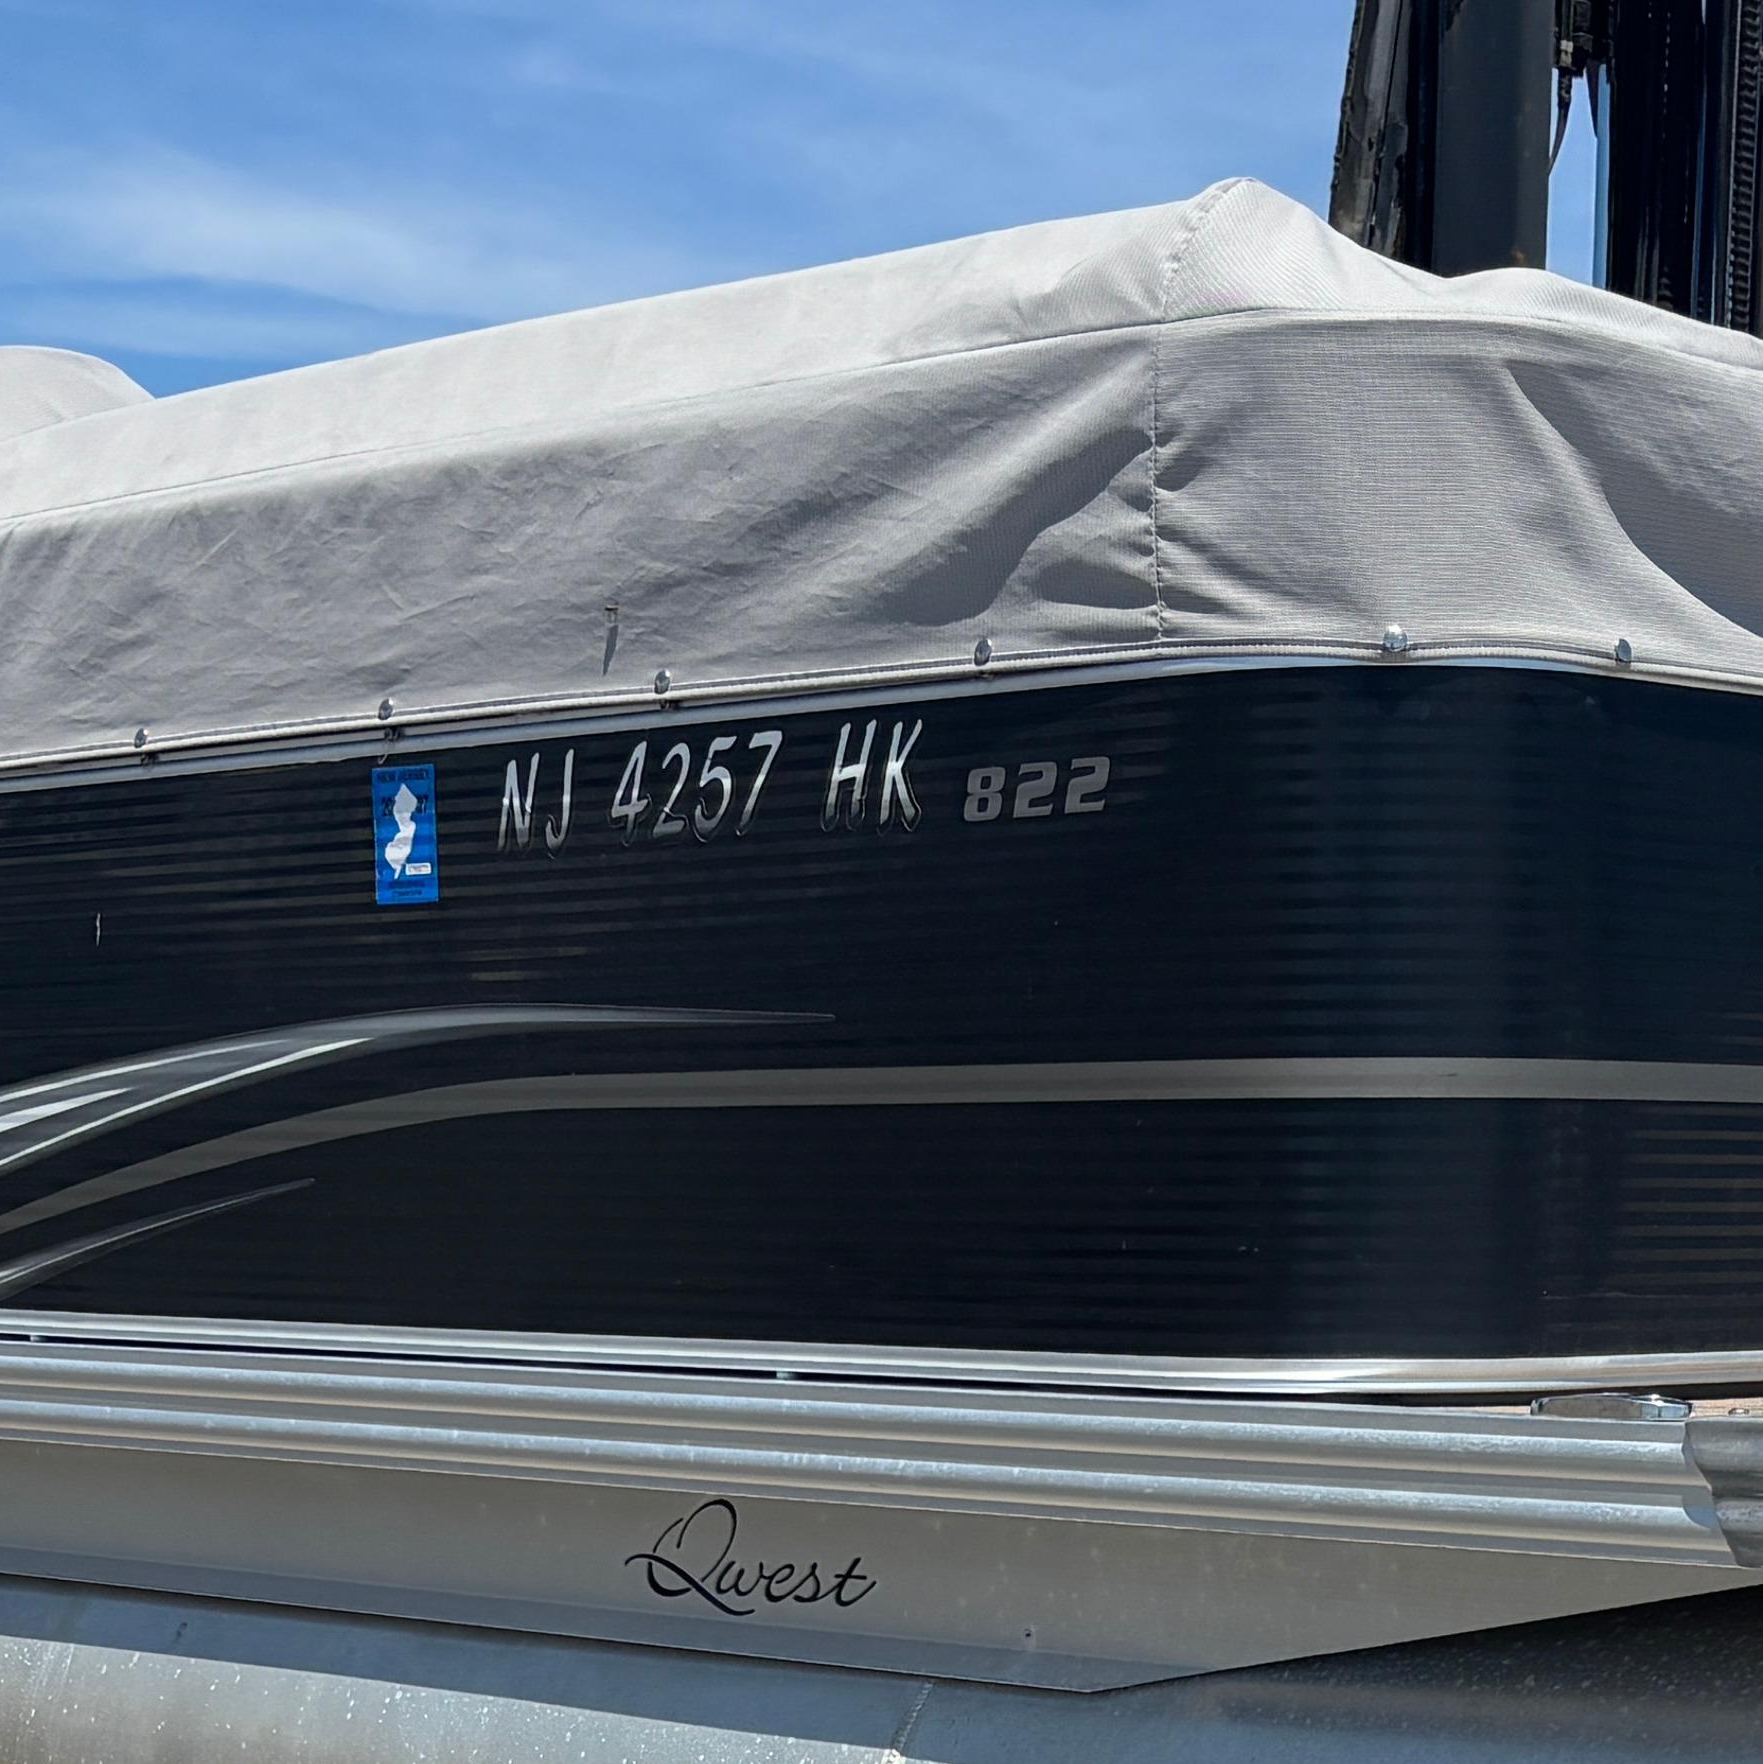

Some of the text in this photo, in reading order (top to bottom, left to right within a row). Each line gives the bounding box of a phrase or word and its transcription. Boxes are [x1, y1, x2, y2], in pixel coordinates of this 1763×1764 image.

[497, 718, 923, 859] NJ 4257 HK
[963, 756, 1110, 823] 822
[624, 1498, 878, 1617] Qwest
